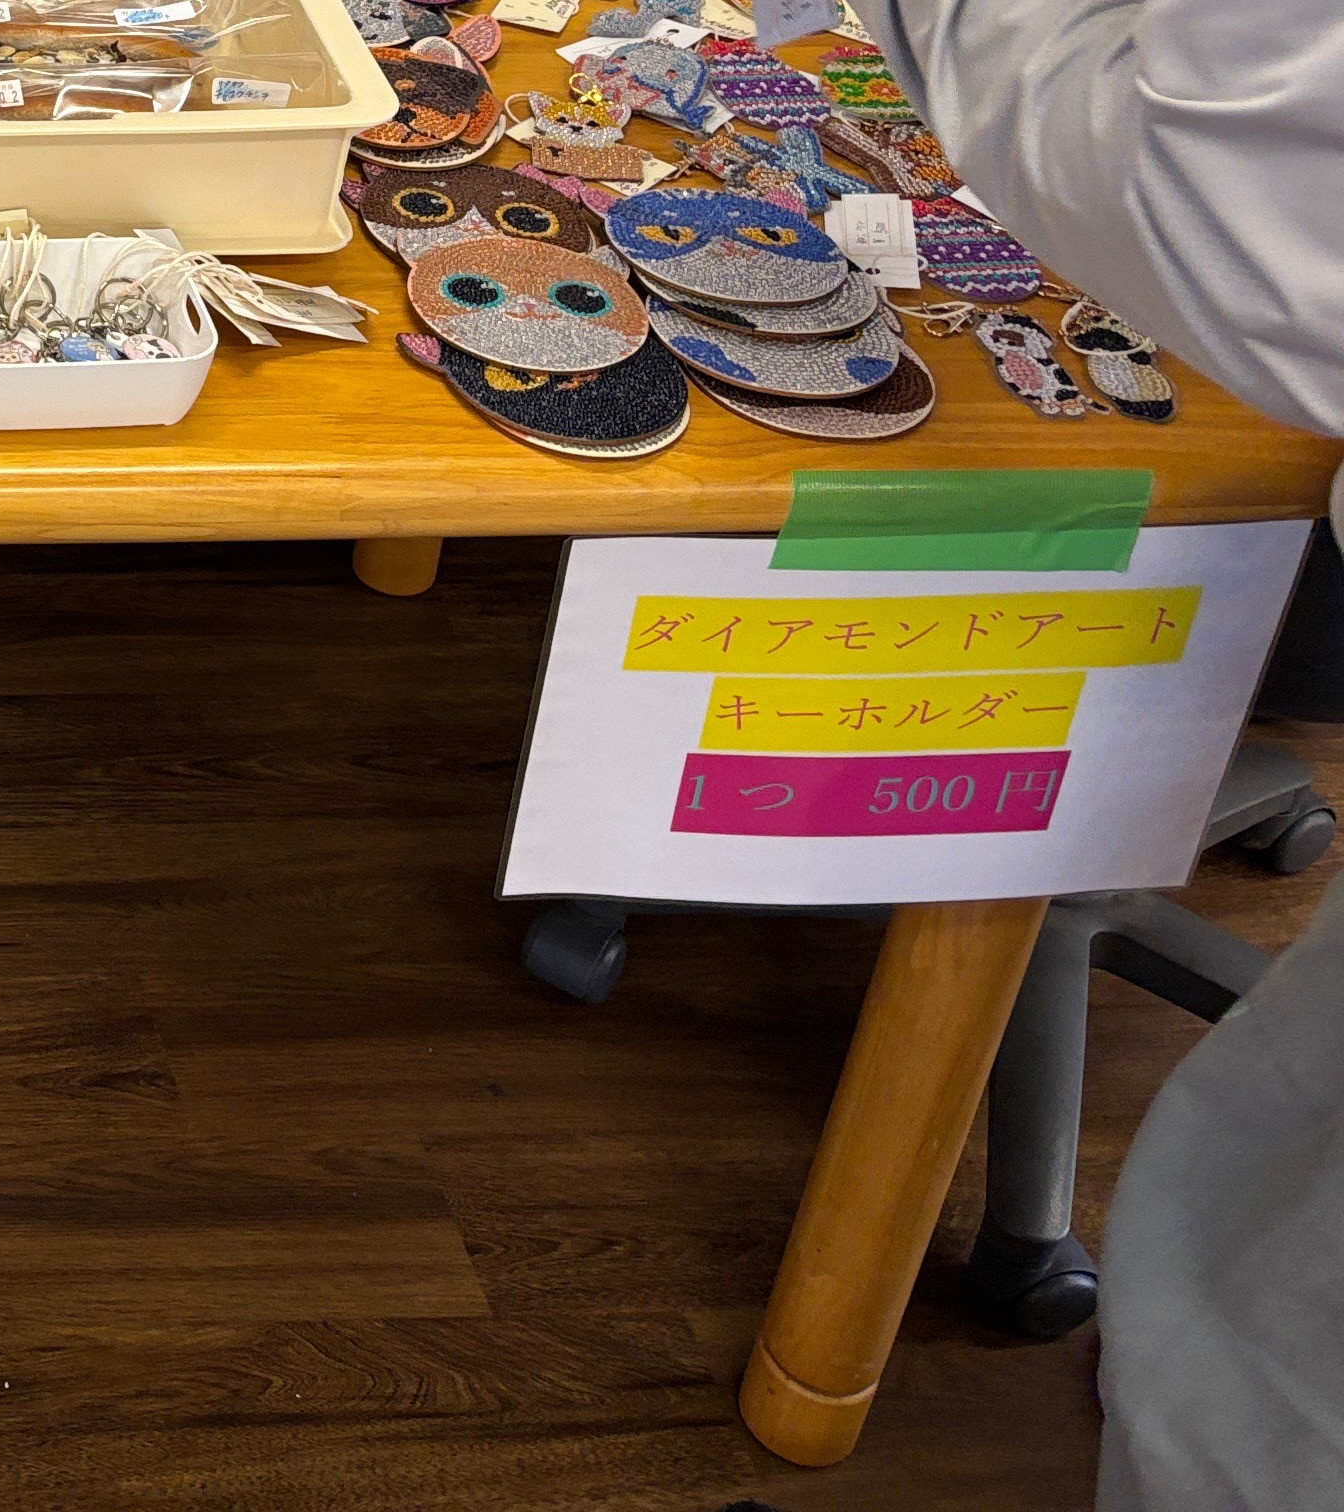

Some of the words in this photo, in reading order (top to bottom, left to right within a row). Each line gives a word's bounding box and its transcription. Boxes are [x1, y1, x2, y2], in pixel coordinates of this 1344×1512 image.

[633, 606, 1180, 656] ダイアモンドアート
[714, 688, 1071, 733] キーホルダー
[681, 773, 795, 813] 1つ
[868, 769, 1060, 817] 500円
